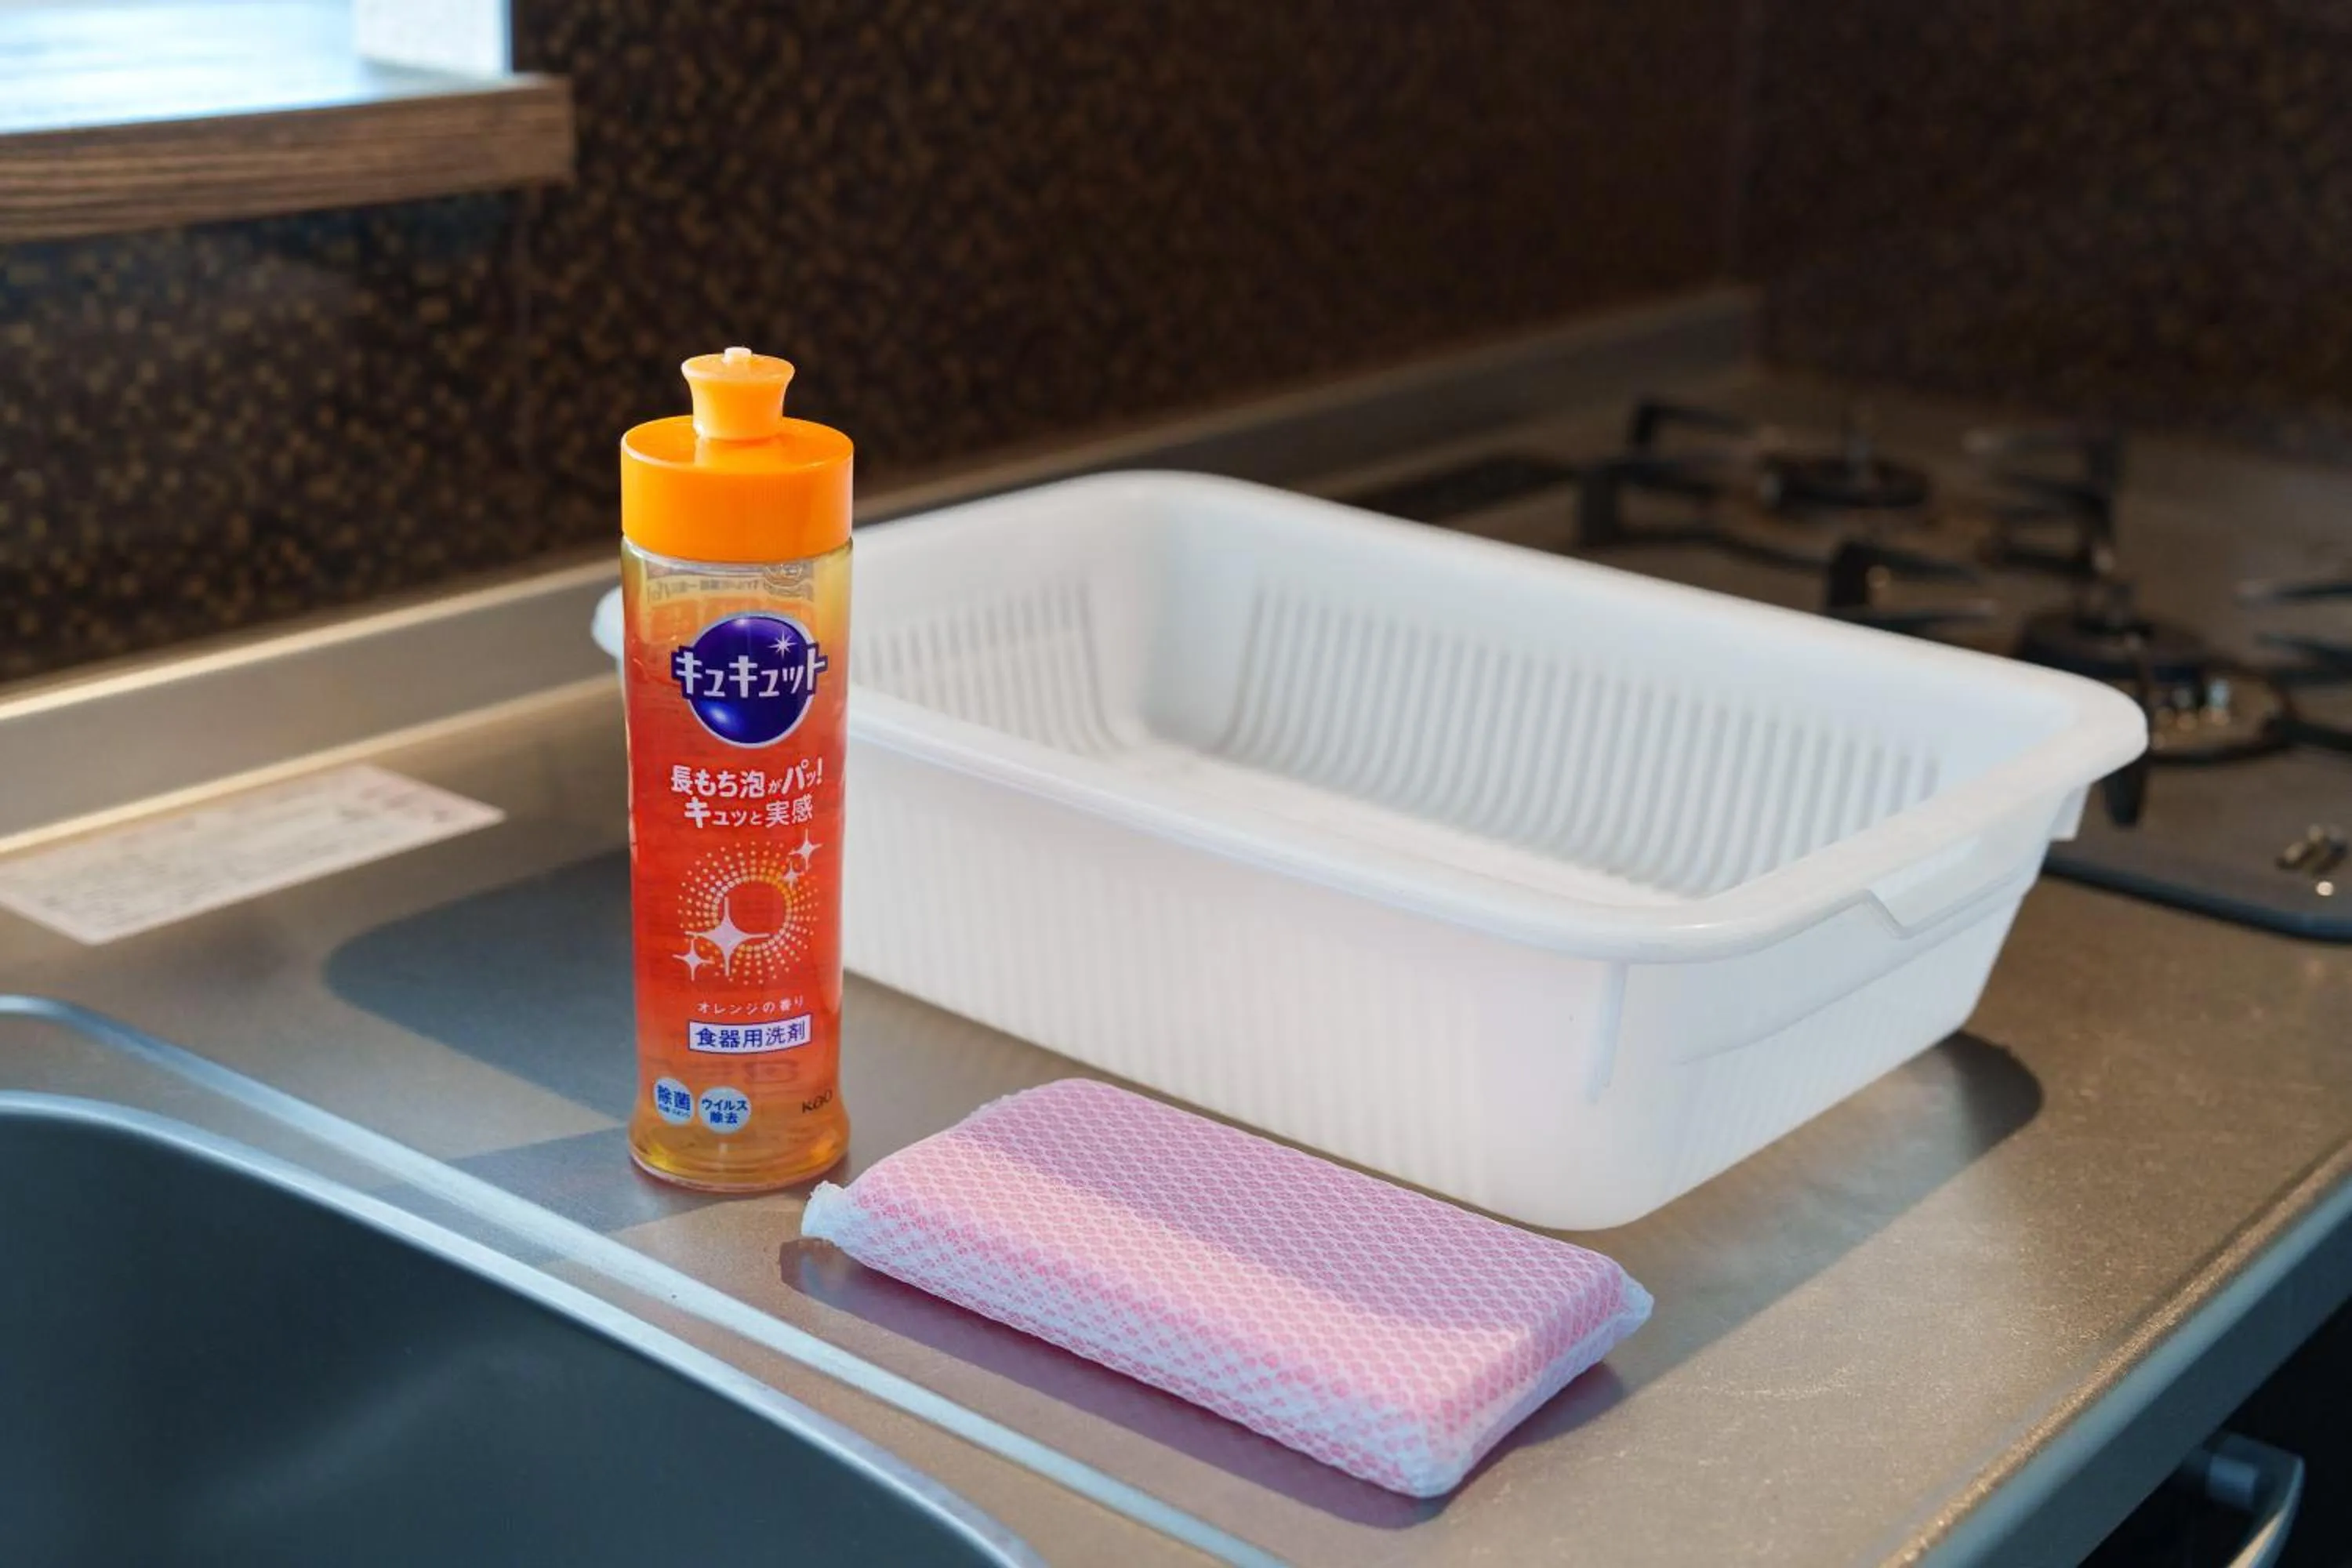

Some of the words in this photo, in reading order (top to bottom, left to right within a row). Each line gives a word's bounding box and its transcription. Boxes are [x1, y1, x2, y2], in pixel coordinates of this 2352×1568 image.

[676, 648, 826, 698] キュキュット
[697, 995, 804, 1014] オレンジの香り
[695, 1021, 805, 1048] 食器用洗剤
[657, 1084, 690, 1111] 除菌
[702, 1098, 748, 1111] ウイルス
[710, 1111, 738, 1123] 除去
